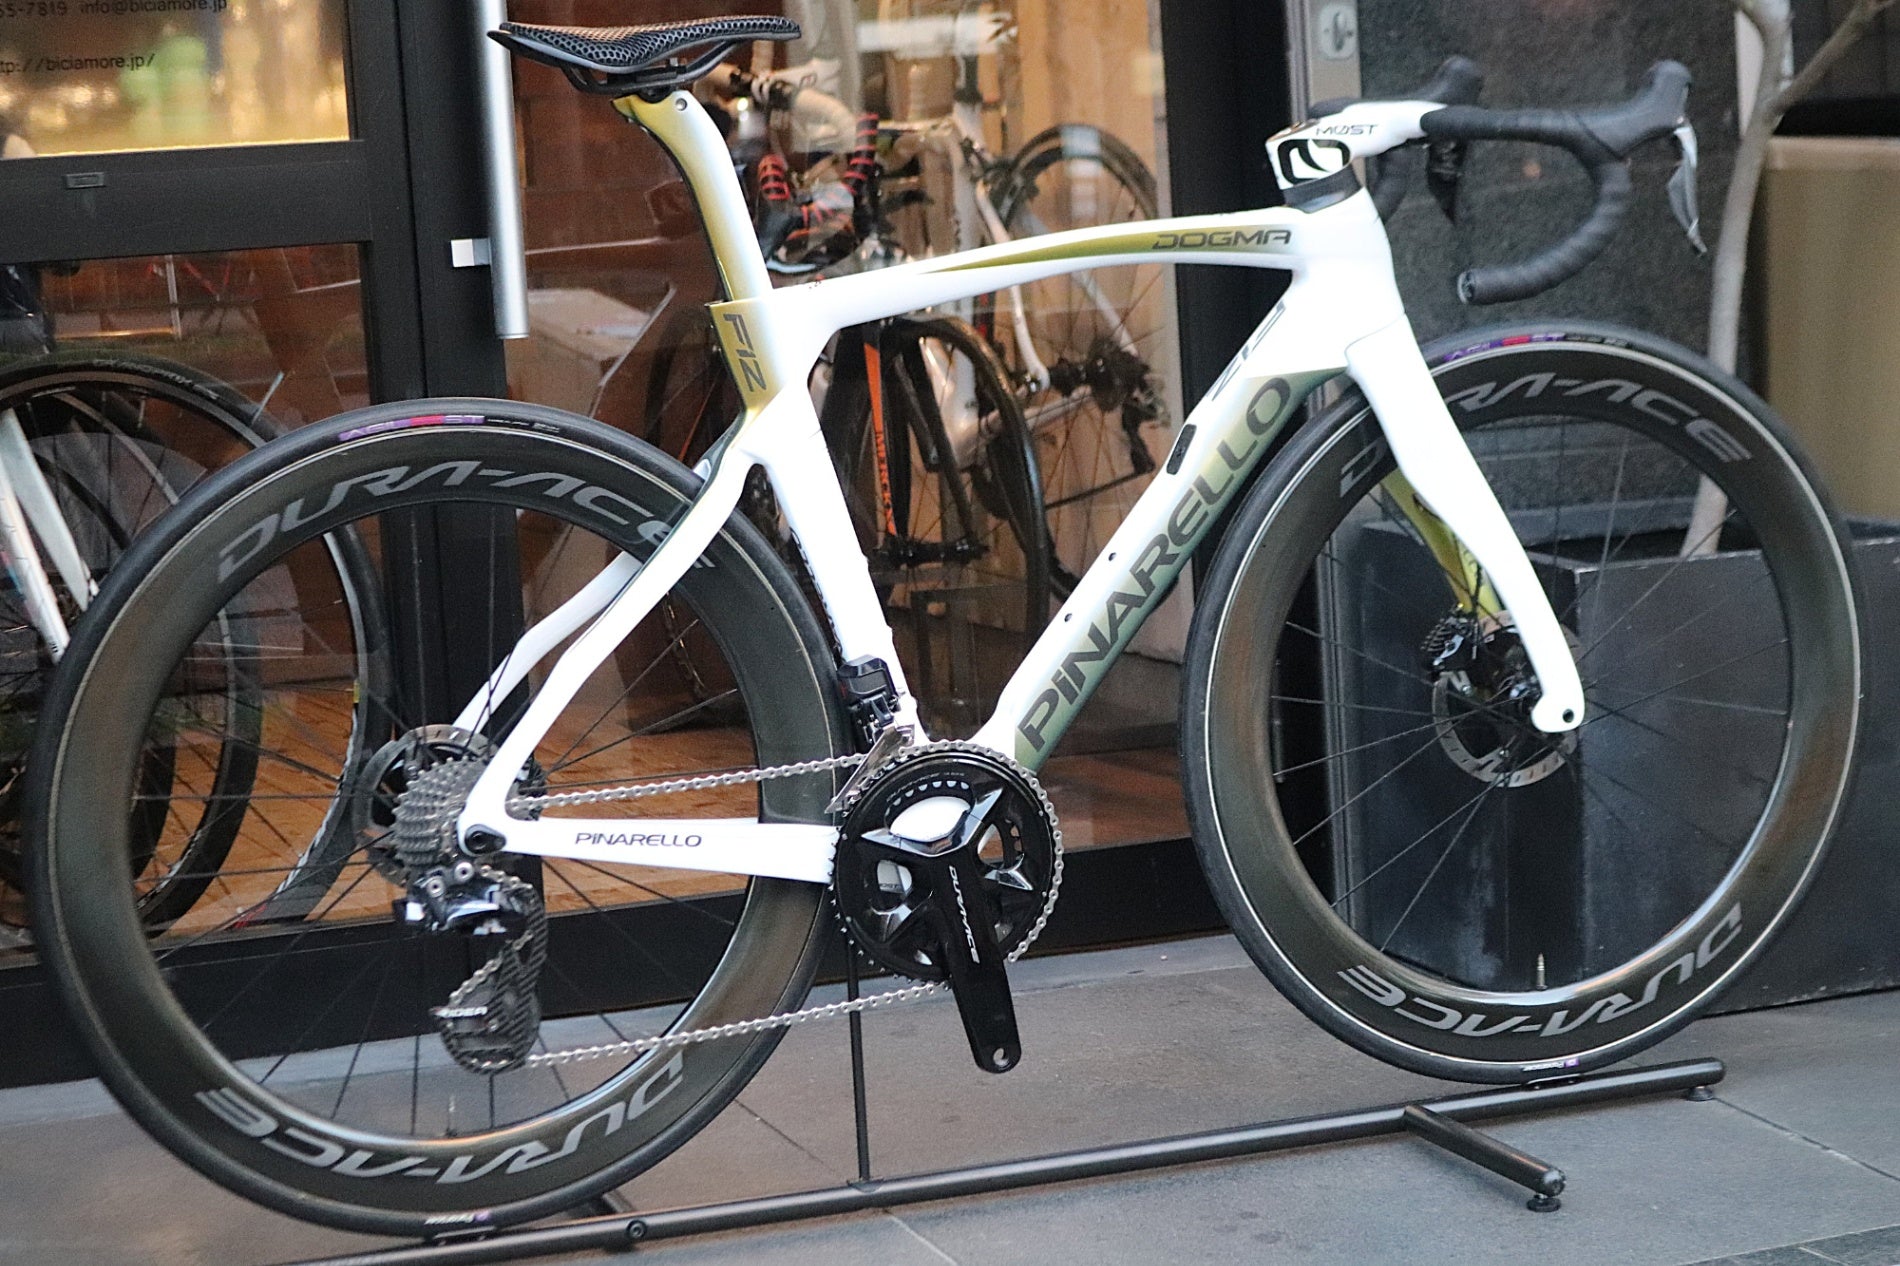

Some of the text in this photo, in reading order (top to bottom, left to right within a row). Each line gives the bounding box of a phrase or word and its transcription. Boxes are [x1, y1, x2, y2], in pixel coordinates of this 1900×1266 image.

[1152, 229, 1292, 250] DOGMA
[1336, 901, 1742, 1038] DURA-ACE
[193, 1049, 684, 1185] DURA-ACE
